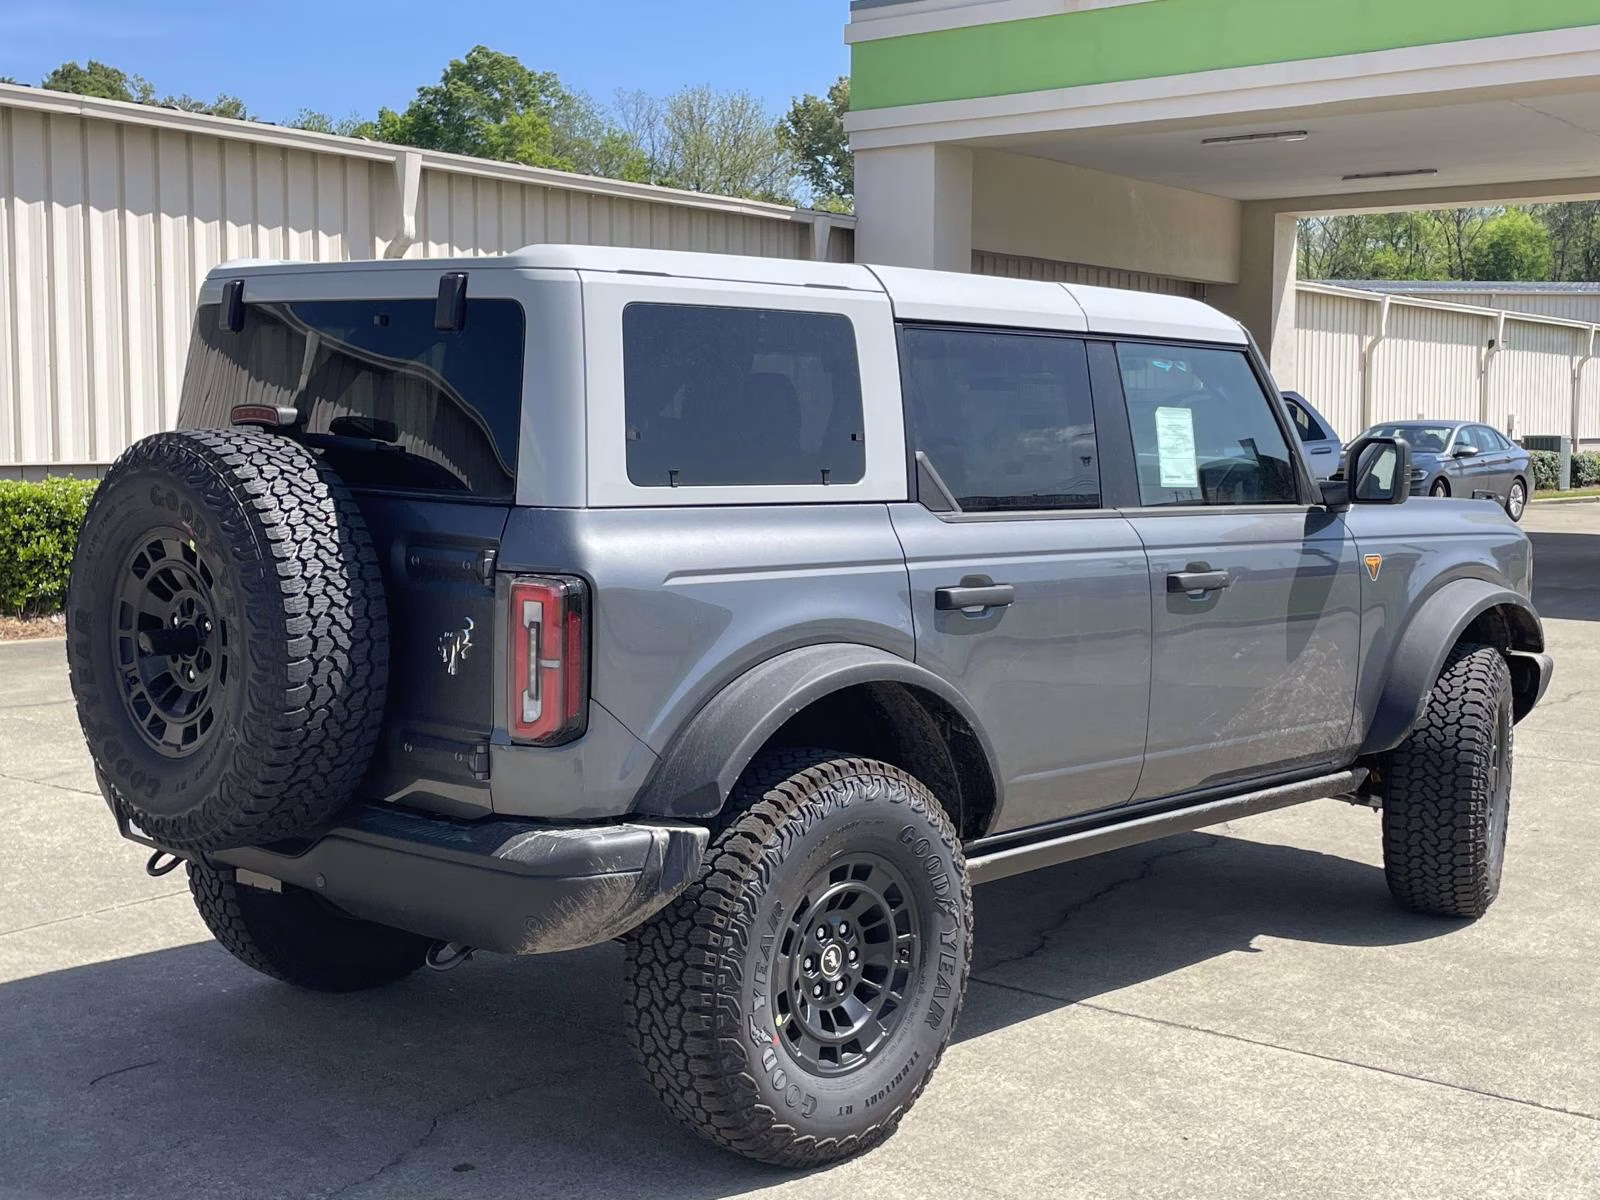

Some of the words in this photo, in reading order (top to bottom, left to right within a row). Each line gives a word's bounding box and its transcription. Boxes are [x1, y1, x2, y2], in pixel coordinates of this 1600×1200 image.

[898, 824, 962, 1030] GOODYEAR
[864, 1049, 922, 1108] TERRITORY
[836, 1104, 854, 1117] RT
